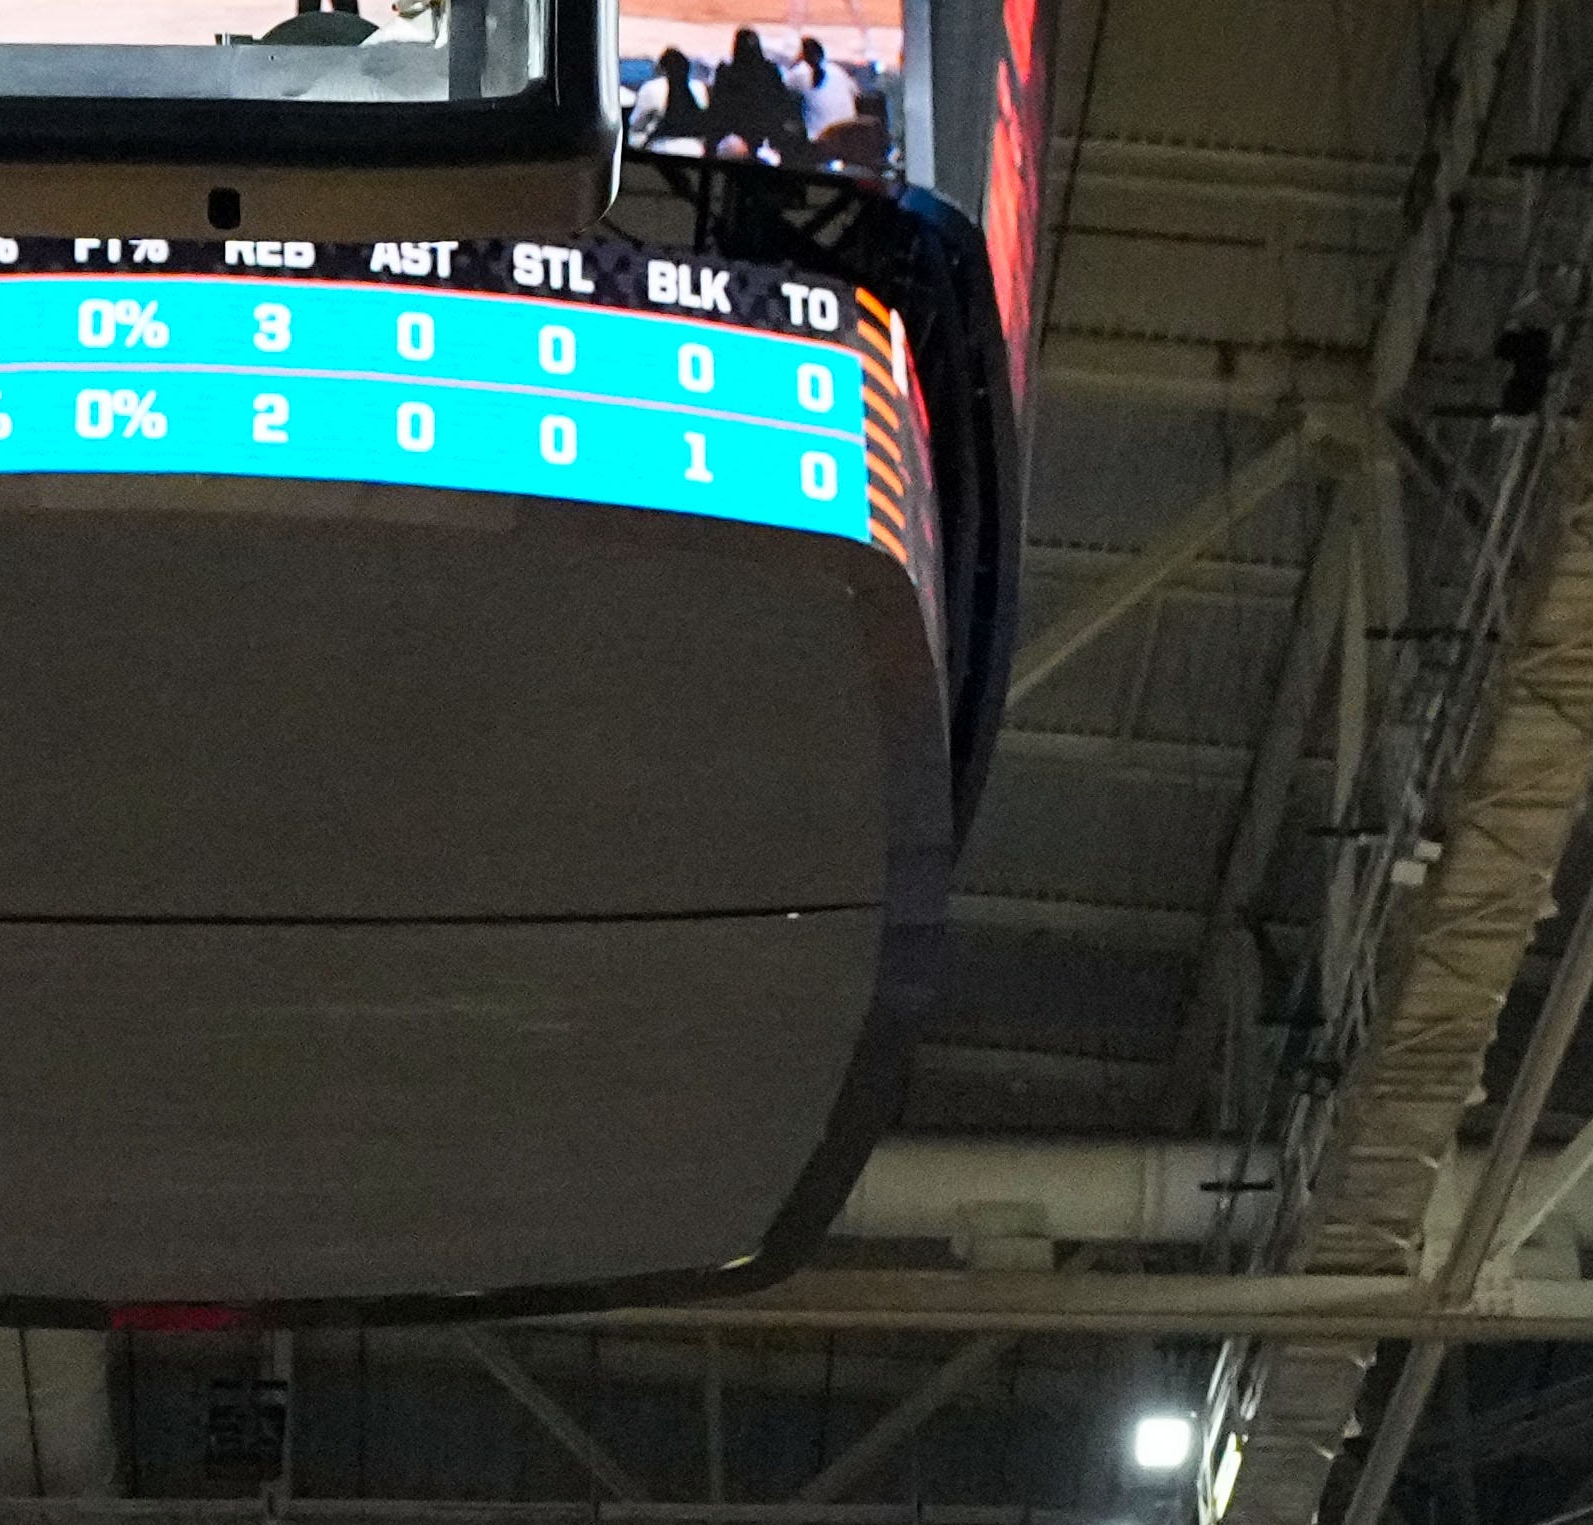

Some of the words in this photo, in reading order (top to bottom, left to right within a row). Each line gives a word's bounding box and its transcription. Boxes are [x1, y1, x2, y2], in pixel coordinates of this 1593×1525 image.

[370, 241, 459, 279] AST
[512, 244, 595, 295] STL
[648, 260, 731, 314] BLK
[781, 283, 839, 332] TO
[77, 298, 170, 349] 0%
[253, 302, 292, 353] 3
[396, 311, 435, 362] 0
[538, 325, 577, 375] 0
[677, 343, 715, 394] 0
[797, 363, 835, 413] 0
[74, 388, 169, 440] 0%
[253, 393, 291, 444] 2
[396, 402, 435, 453] 0
[539, 415, 578, 466] 0
[683, 432, 714, 484] 1
[799, 451, 838, 502] 0
